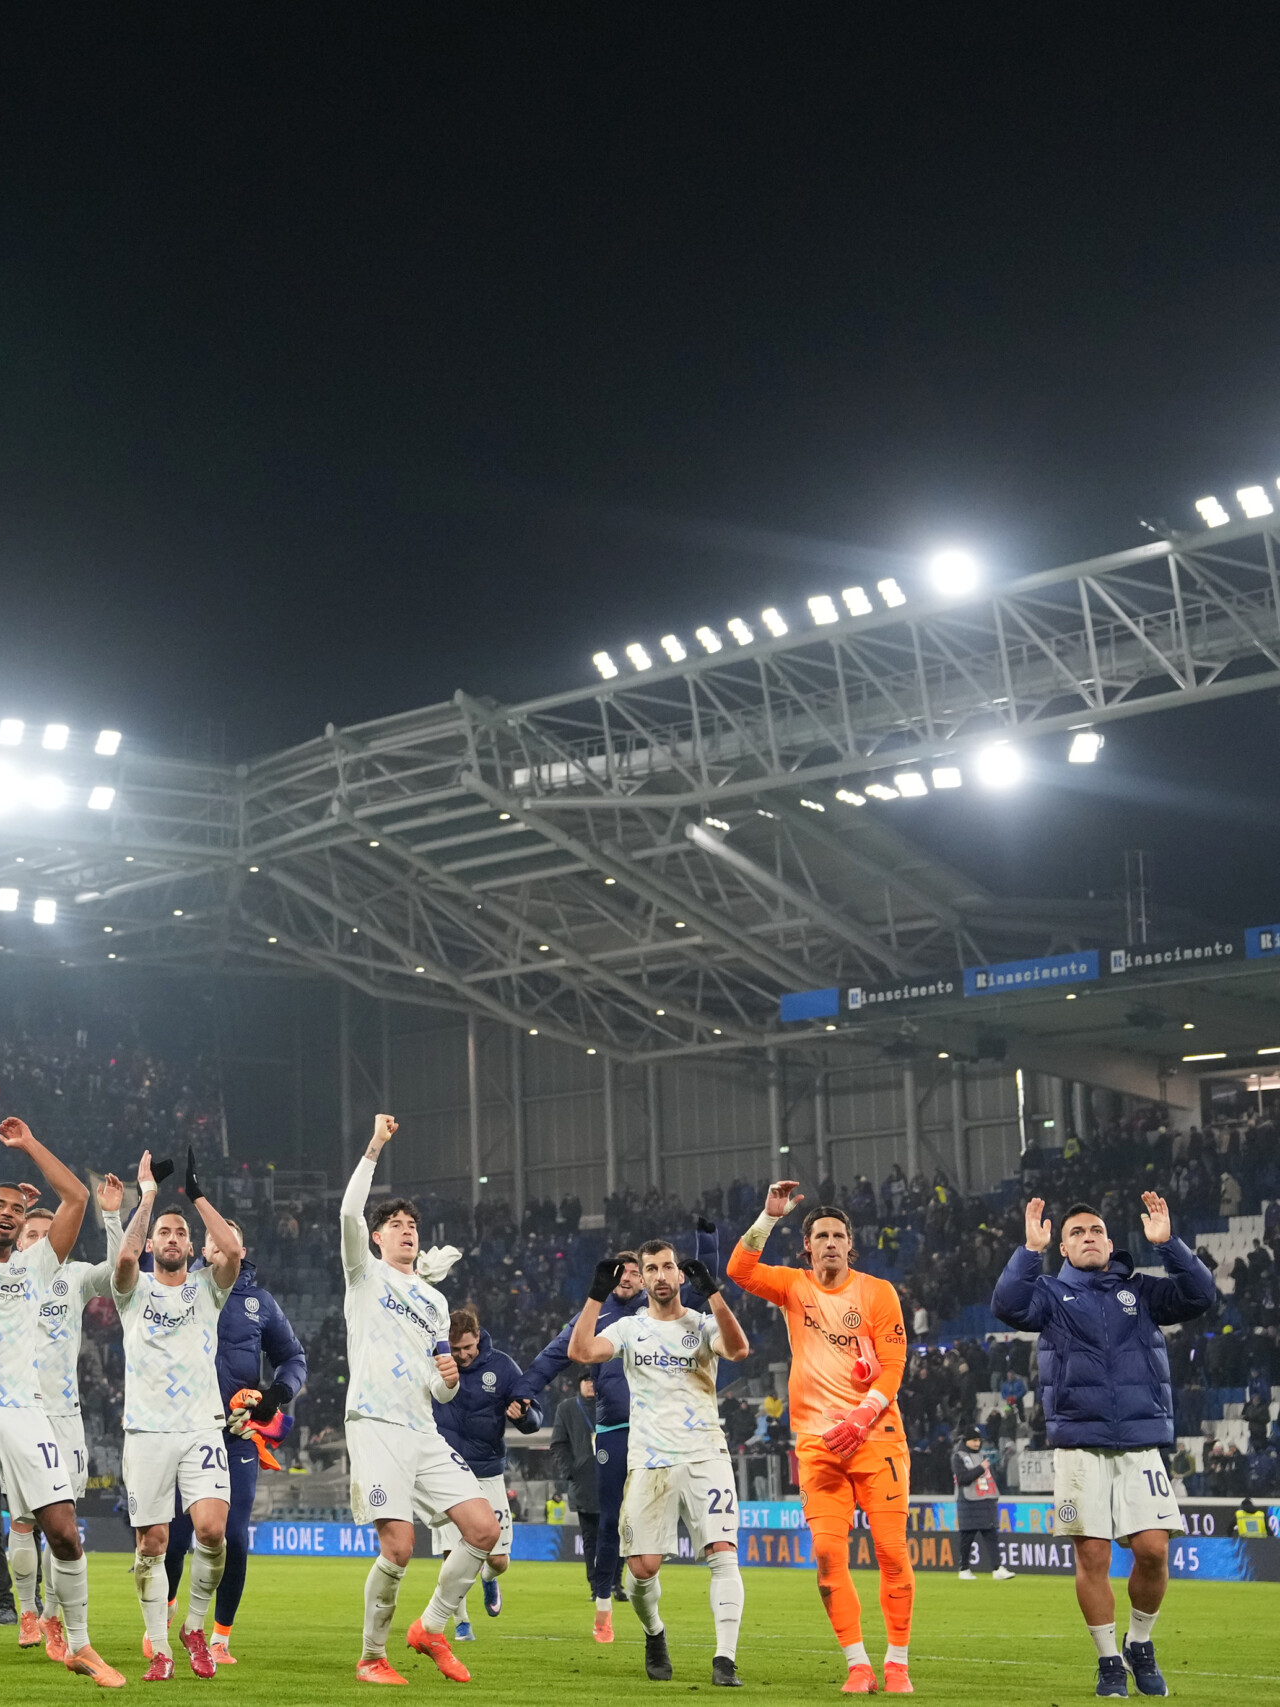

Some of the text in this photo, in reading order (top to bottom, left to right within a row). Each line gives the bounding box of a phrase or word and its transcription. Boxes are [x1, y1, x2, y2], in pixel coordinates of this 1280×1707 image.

[1111, 942, 1233, 971] Rinascimento
[976, 961, 1087, 988] Rinascimento
[634, 1351, 699, 1368] betsson
[37, 1442, 60, 1469] 17
[199, 1445, 228, 1472] 20
[884, 1456, 898, 1482] 1
[1142, 1469, 1170, 1498] 10
[707, 1488, 735, 1515] 22
[272, 1526, 325, 1551] HOME
[339, 1527, 380, 1552] MAT
[910, 1537, 954, 1567] OMA
[998, 1542, 1077, 1568] GENNAI
